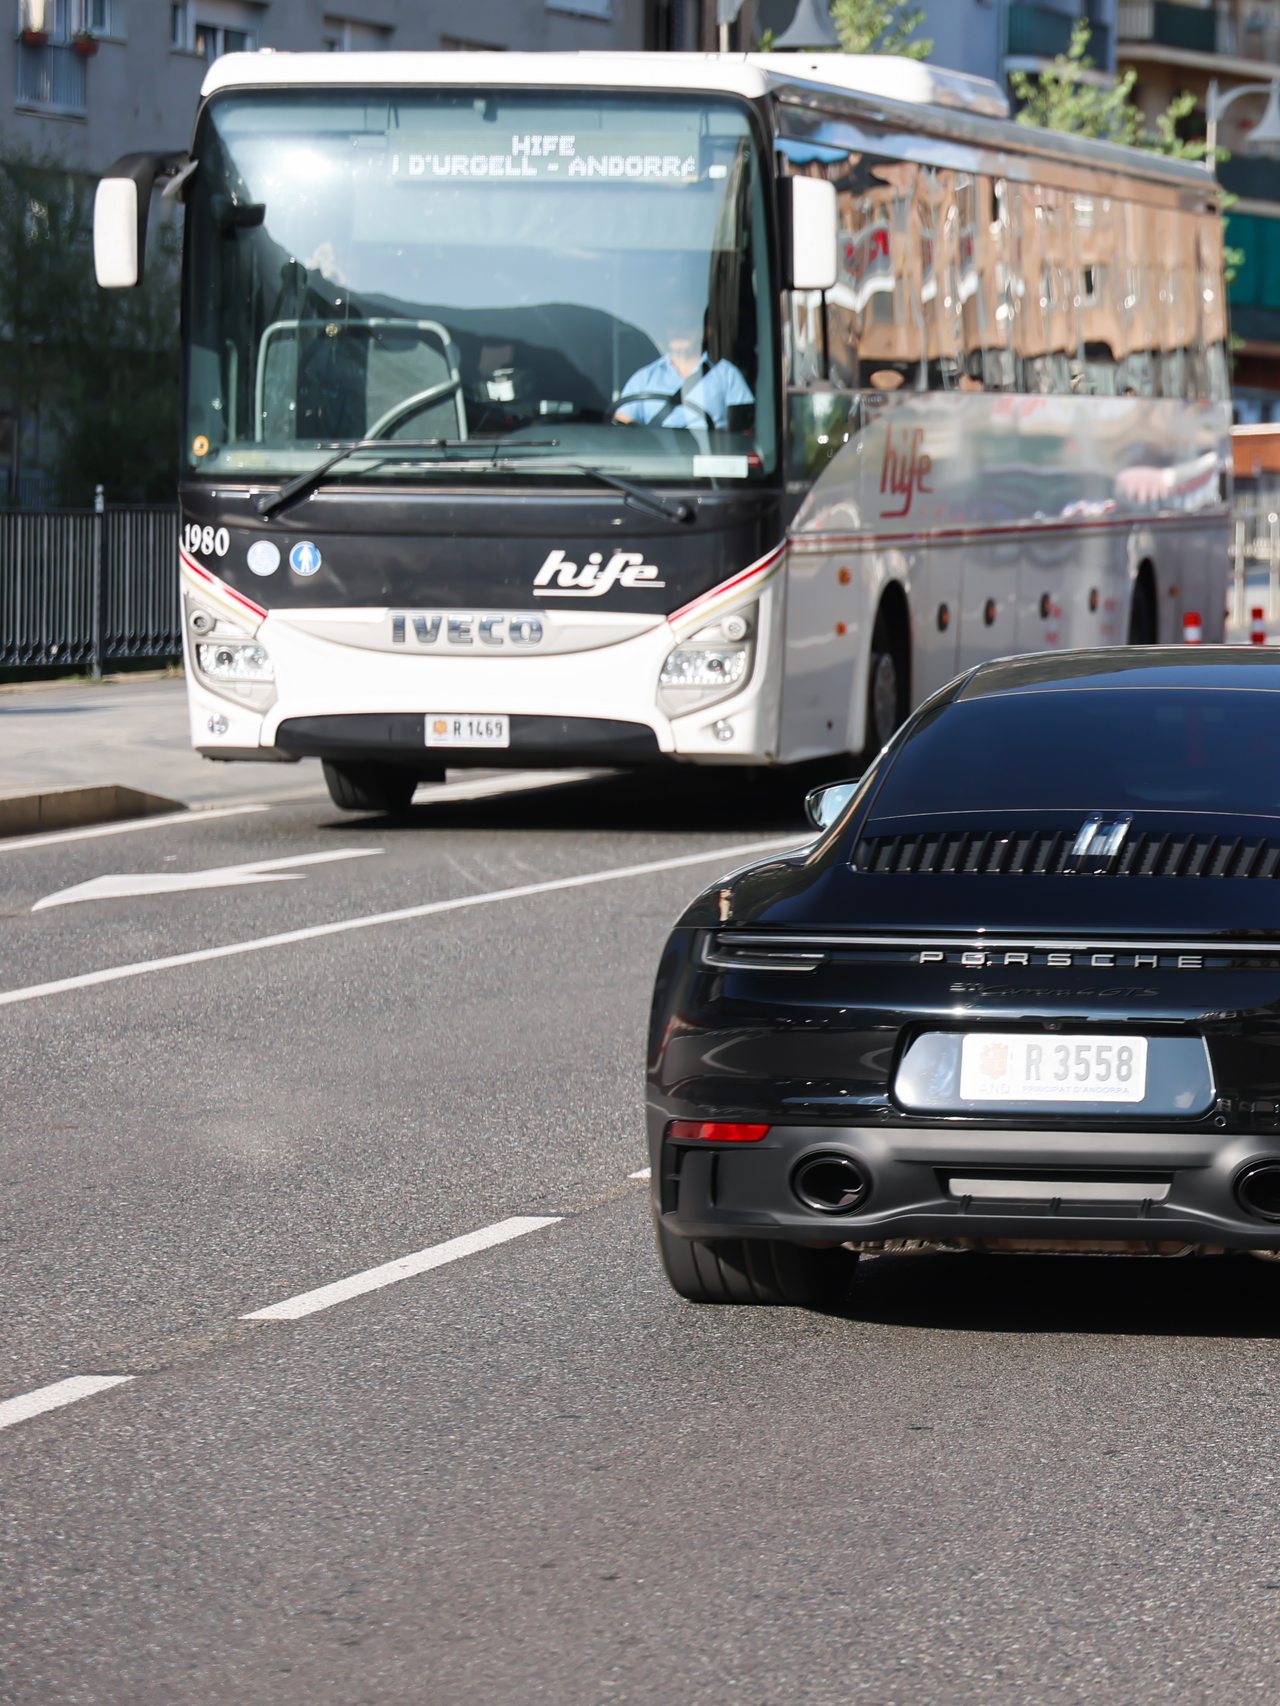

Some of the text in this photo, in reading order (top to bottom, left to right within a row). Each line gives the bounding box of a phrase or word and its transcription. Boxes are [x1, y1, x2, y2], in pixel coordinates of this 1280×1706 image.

[511, 135, 576, 156] HIFE
[408, 154, 538, 177] D'URGELL
[568, 155, 695, 178] ANDORRA
[880, 423, 935, 518] hife
[184, 523, 230, 556] 1980
[533, 550, 666, 597] hife
[392, 614, 543, 646] IVECO
[454, 720, 503, 738] R 1469
[919, 951, 1202, 968] PORSCHE
[980, 984, 1073, 997] Carrera
[1098, 987, 1160, 998] GTS
[1025, 1044, 1133, 1082] R 3558
[979, 1083, 1011, 1095] AND
[1022, 1085, 1130, 1094] PRINCIPAT D'ANDORRA
